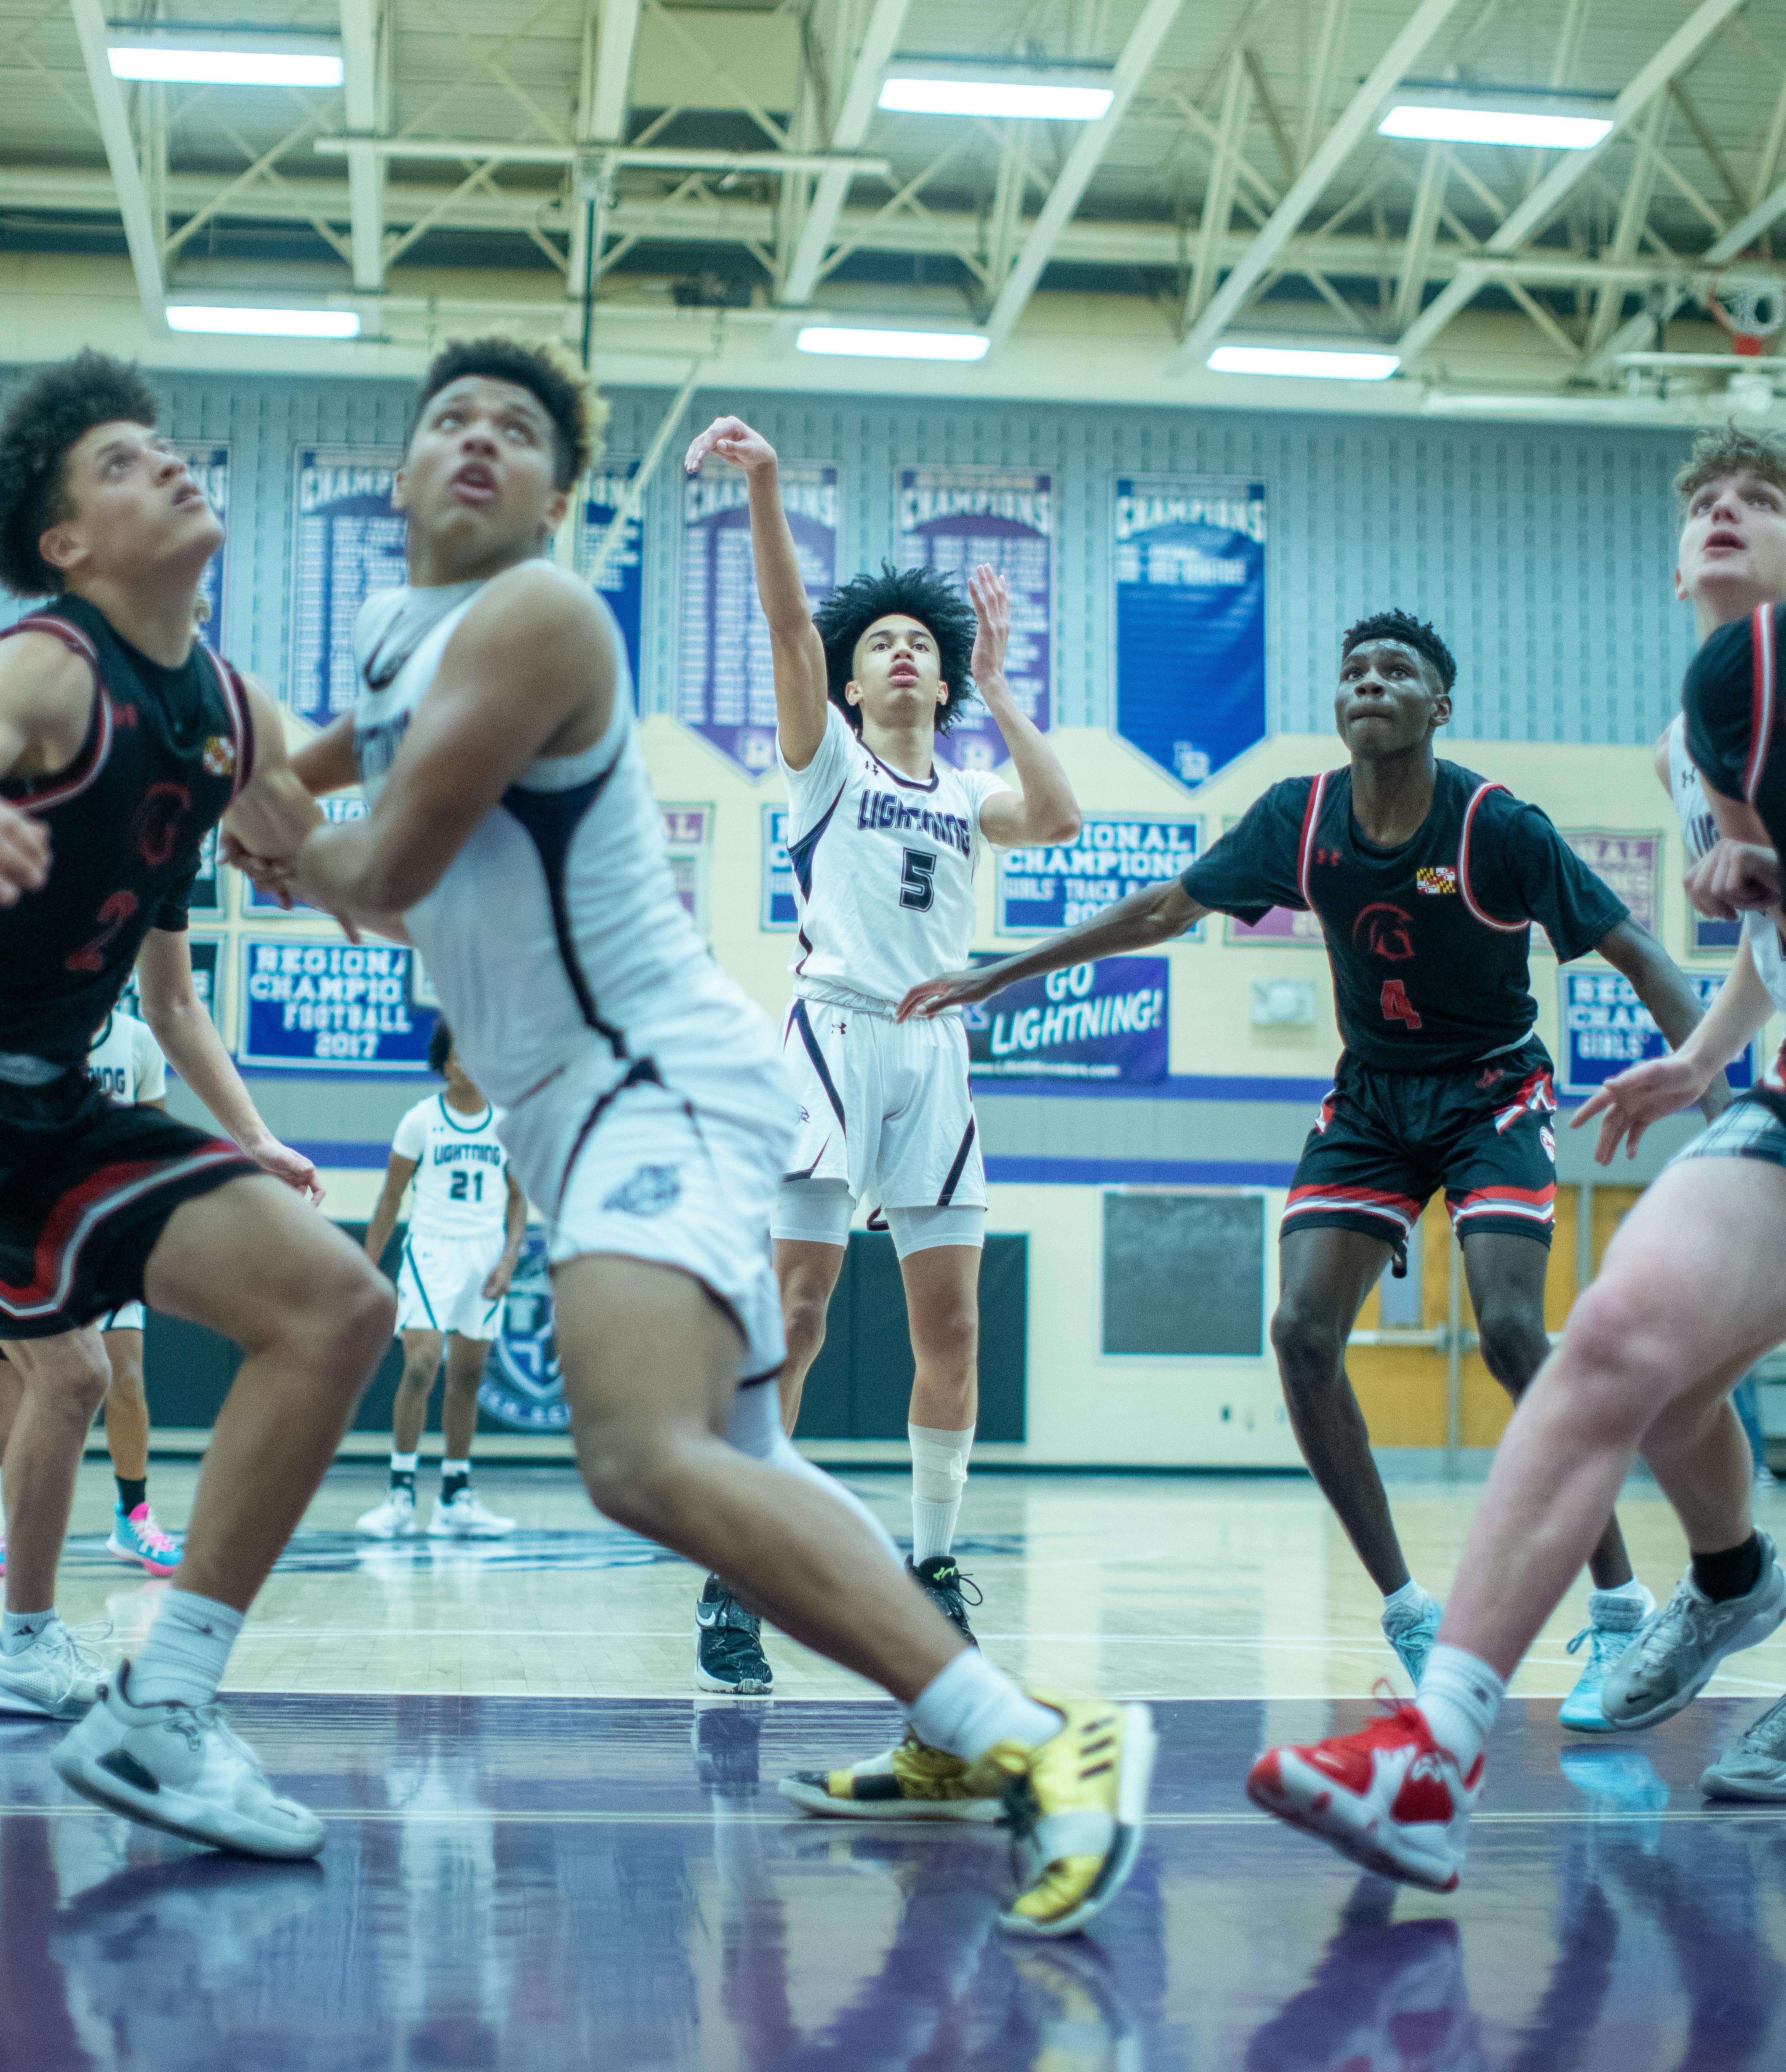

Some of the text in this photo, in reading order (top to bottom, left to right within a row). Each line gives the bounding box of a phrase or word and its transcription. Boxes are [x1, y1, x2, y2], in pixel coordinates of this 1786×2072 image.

[904, 480, 1050, 533] CHAMPIONS
[1118, 492, 1265, 542] CHAMPIONS
[858, 789, 971, 860] LIGHTNING
[899, 847, 937, 913] 5
[65, 890, 137, 972] 2
[251, 974, 403, 1004] CHAMPIO
[1045, 962, 1094, 1002] GO
[1380, 980, 1422, 1029] 4
[284, 1003, 413, 1033] FOOTBALL
[991, 988, 1163, 1056] LIGHTNING!
[315, 1032, 378, 1058] 2017
[434, 1143, 500, 1167] LIGHTNING
[449, 1170, 483, 1202] 21
